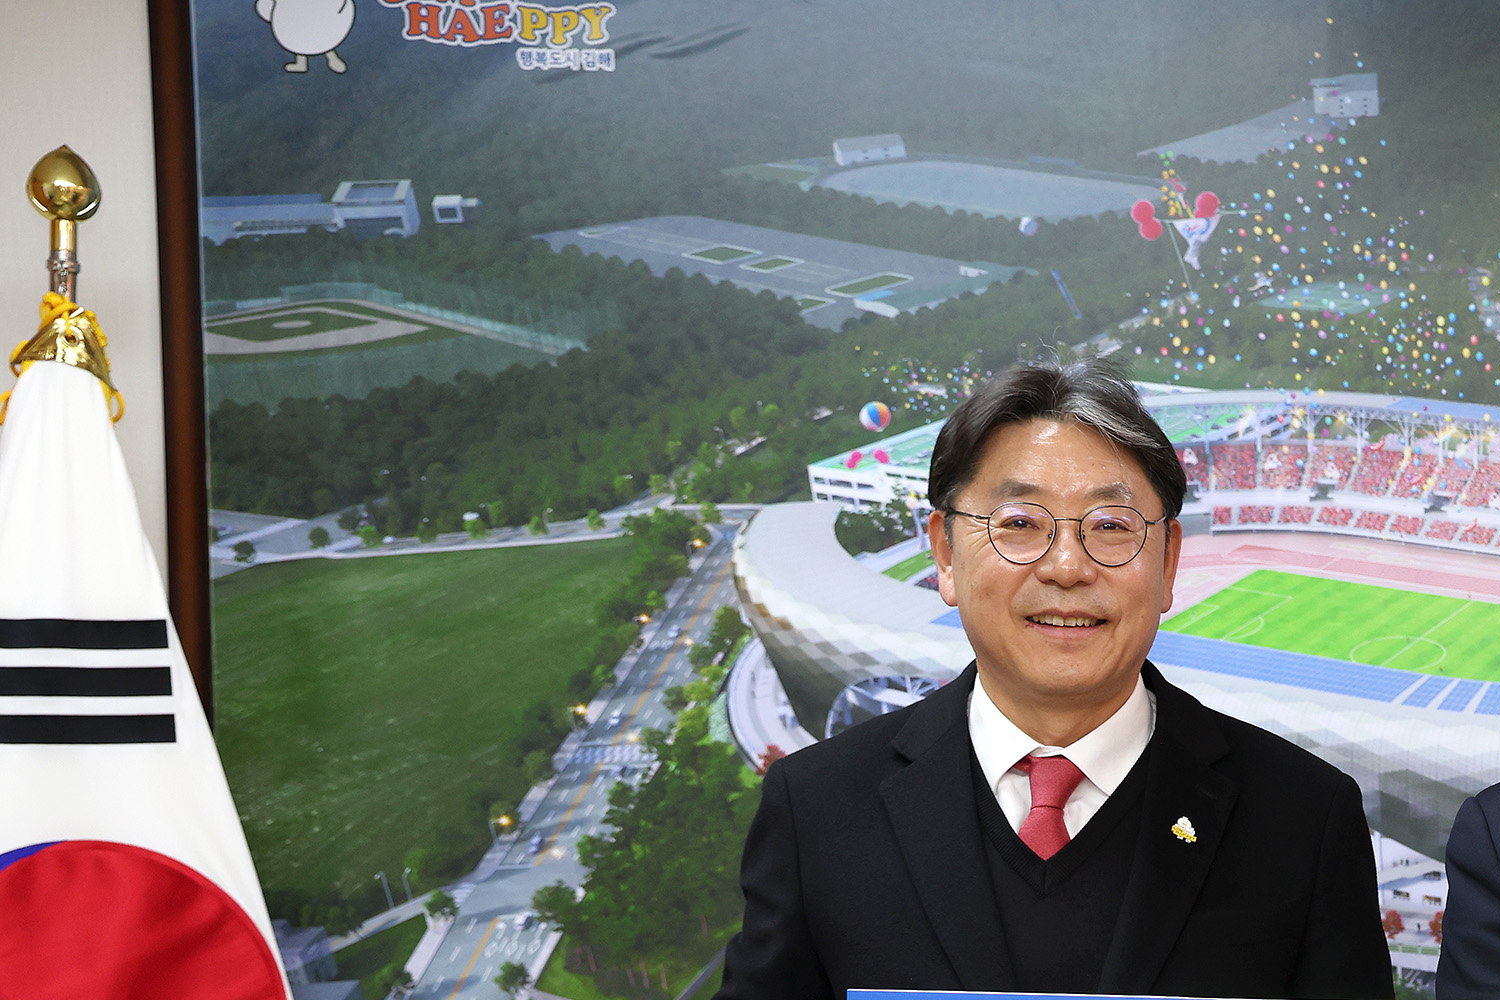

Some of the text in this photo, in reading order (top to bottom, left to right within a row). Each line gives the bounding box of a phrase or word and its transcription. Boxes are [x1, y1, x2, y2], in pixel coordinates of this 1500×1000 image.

[405, 2, 611, 45] HAEPPY
[520, 50, 613, 70] 행복도시 김해
